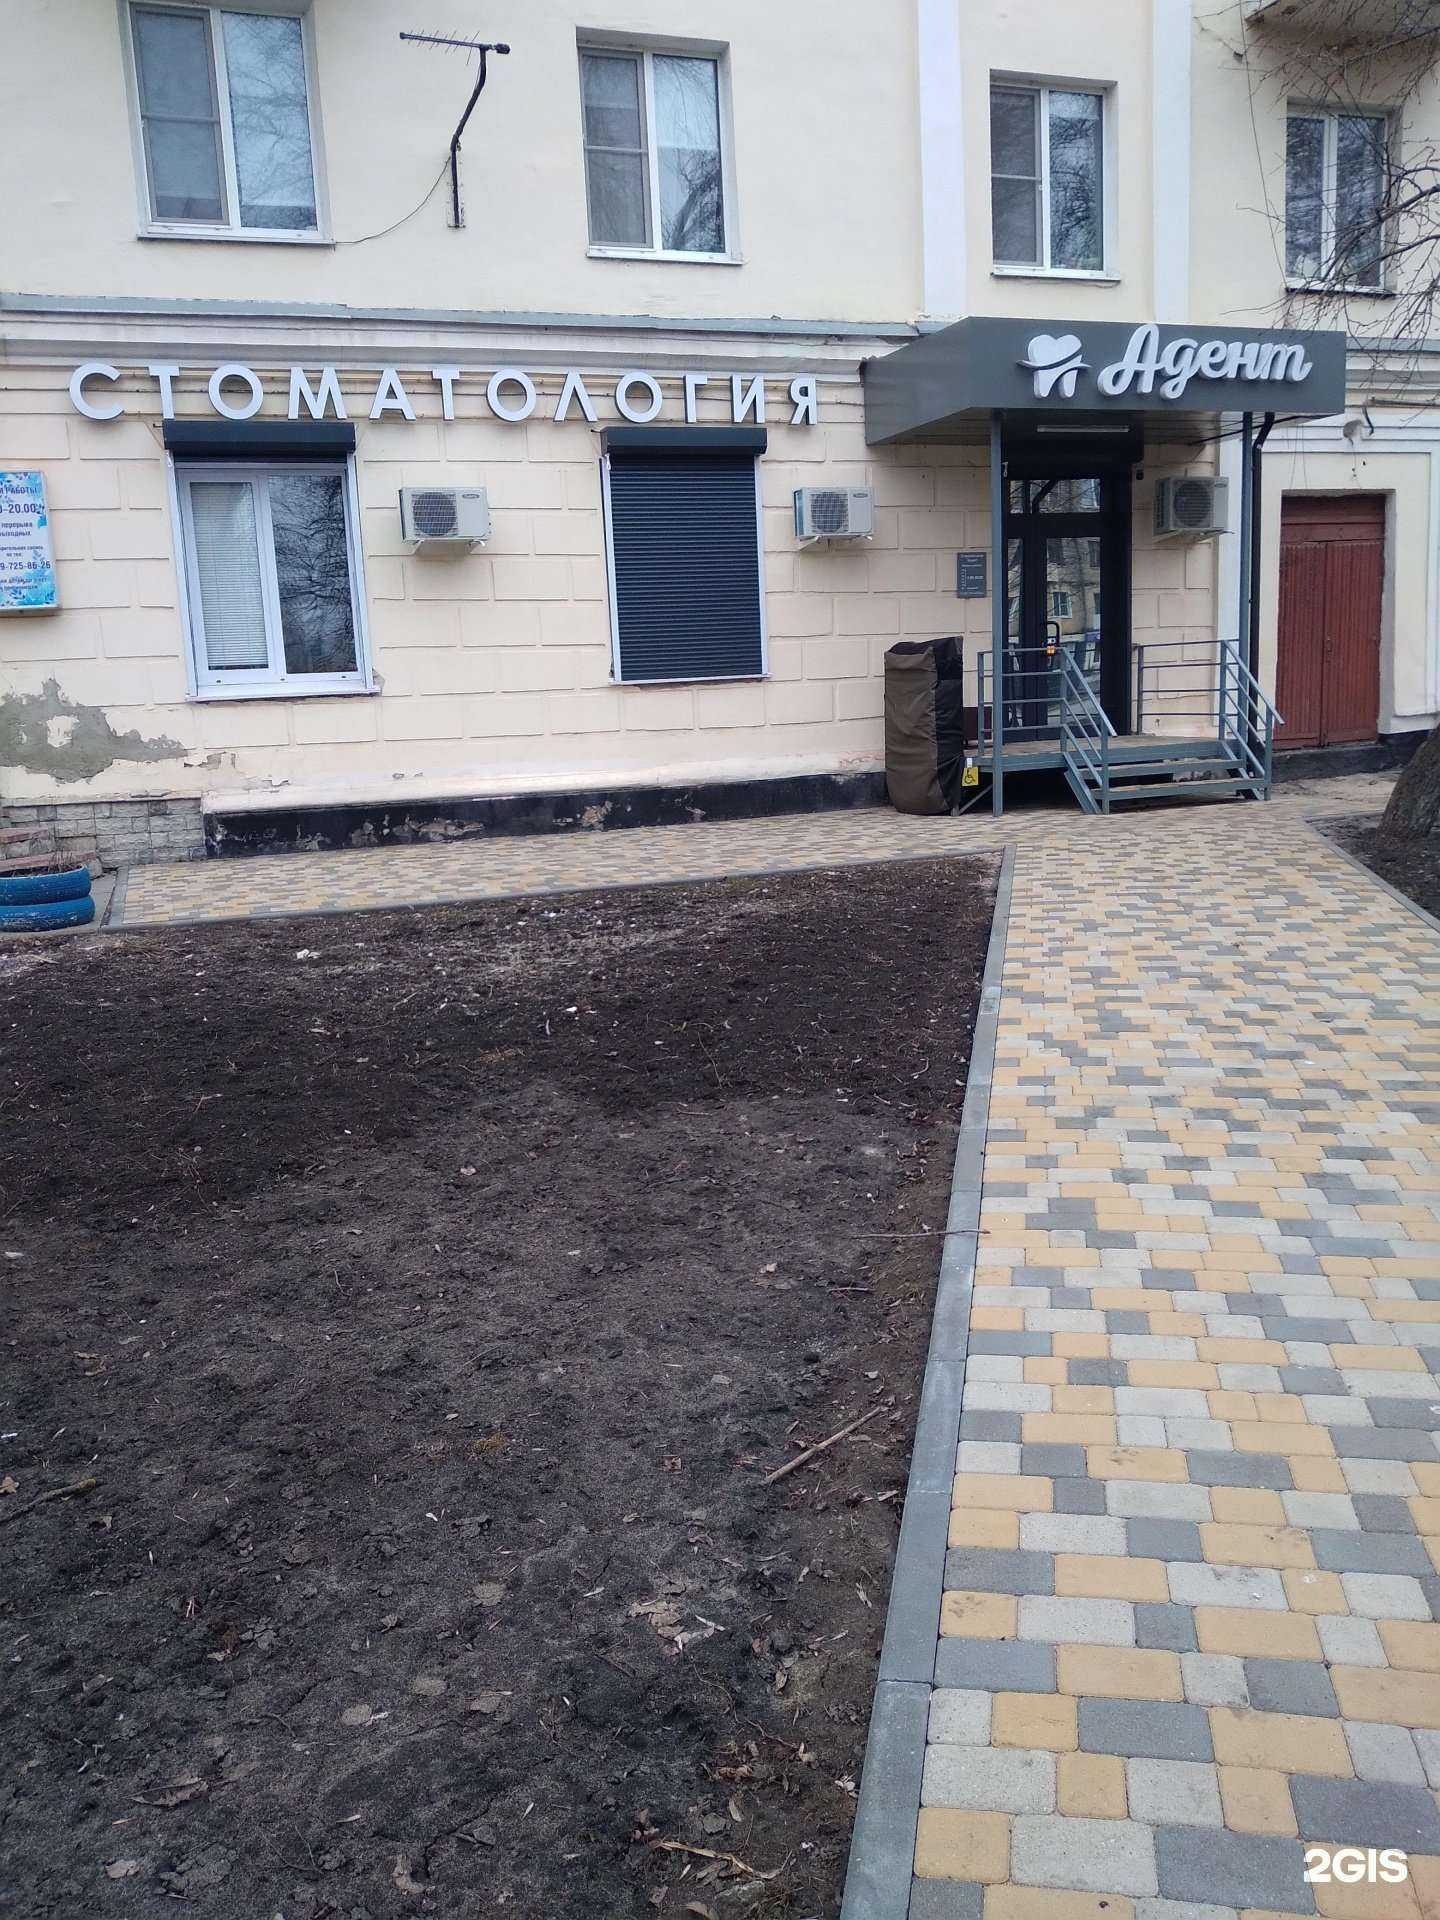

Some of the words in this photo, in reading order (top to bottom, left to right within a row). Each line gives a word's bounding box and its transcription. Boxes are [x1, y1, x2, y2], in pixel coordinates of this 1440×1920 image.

[68, 361, 817, 426] СТОМАТОЛОГИЯ
[1097, 323, 1313, 399] Адент
[5, 486, 37, 495] РАБОТЫ
